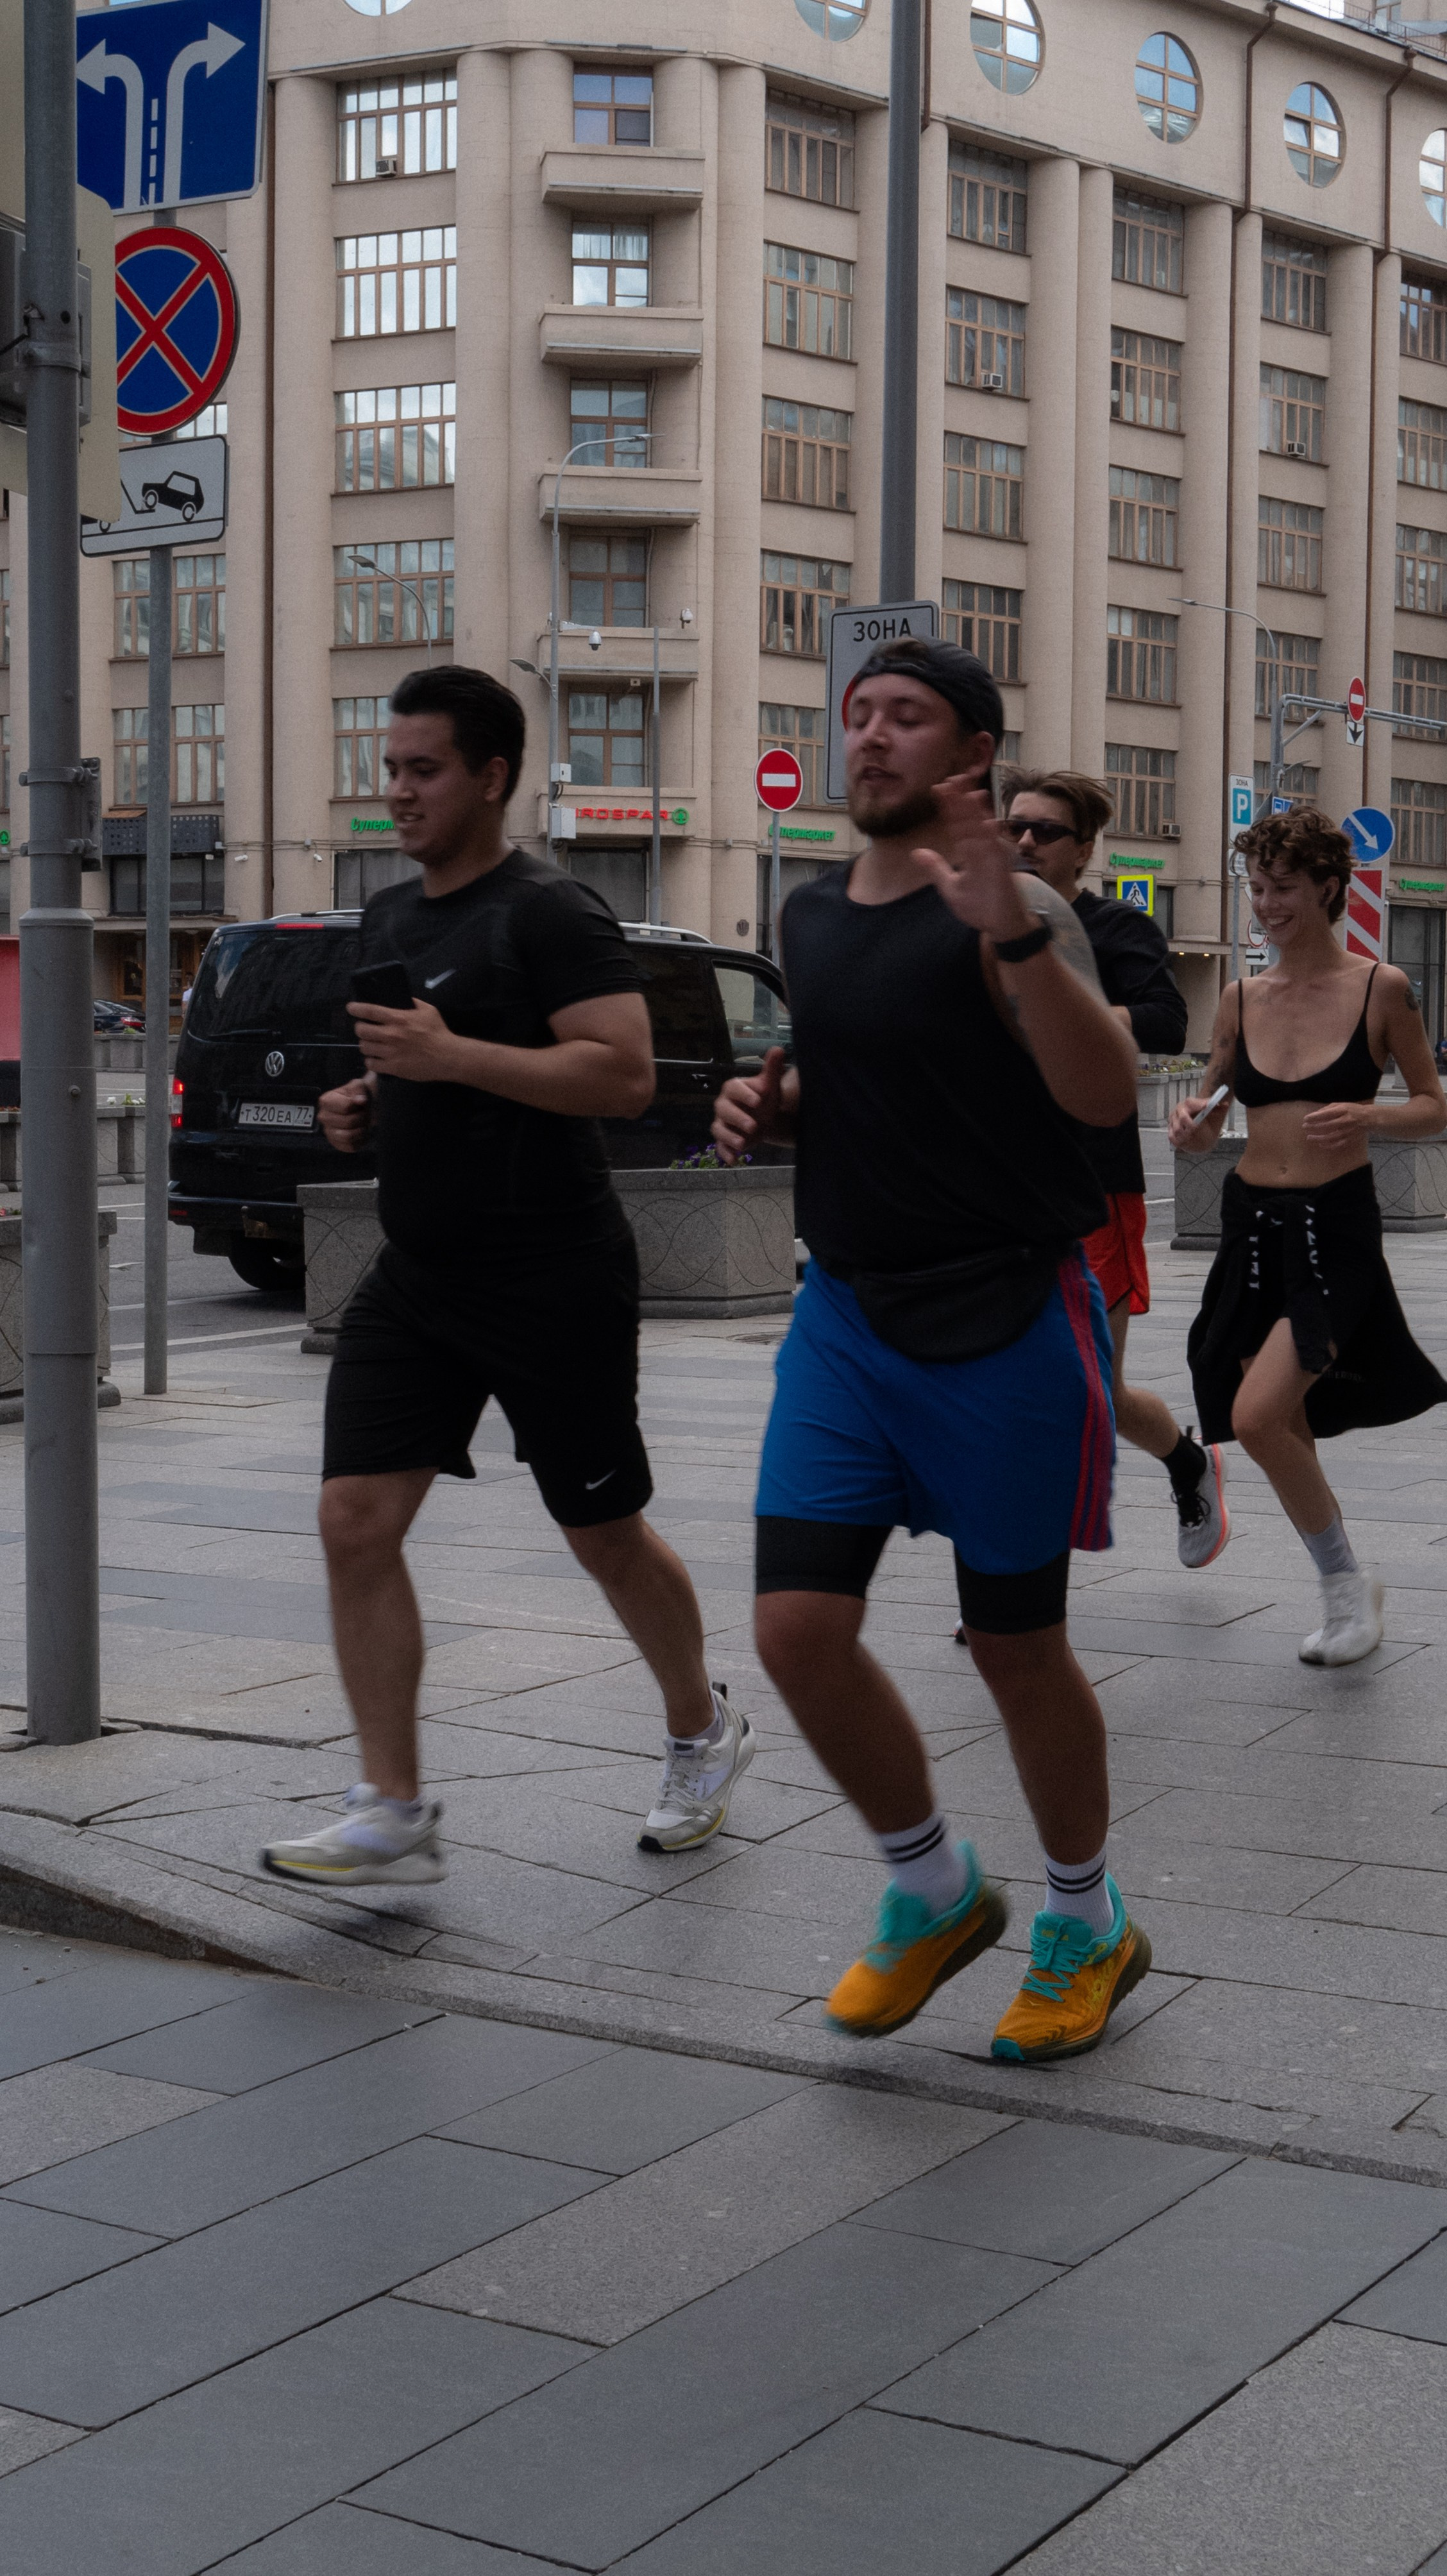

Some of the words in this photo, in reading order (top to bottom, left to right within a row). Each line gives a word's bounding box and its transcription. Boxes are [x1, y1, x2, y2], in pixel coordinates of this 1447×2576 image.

[853, 618, 911, 642] ЗОНА
[575, 808, 668, 820] ROSPAR
[768, 824, 835, 841] Спермаркет
